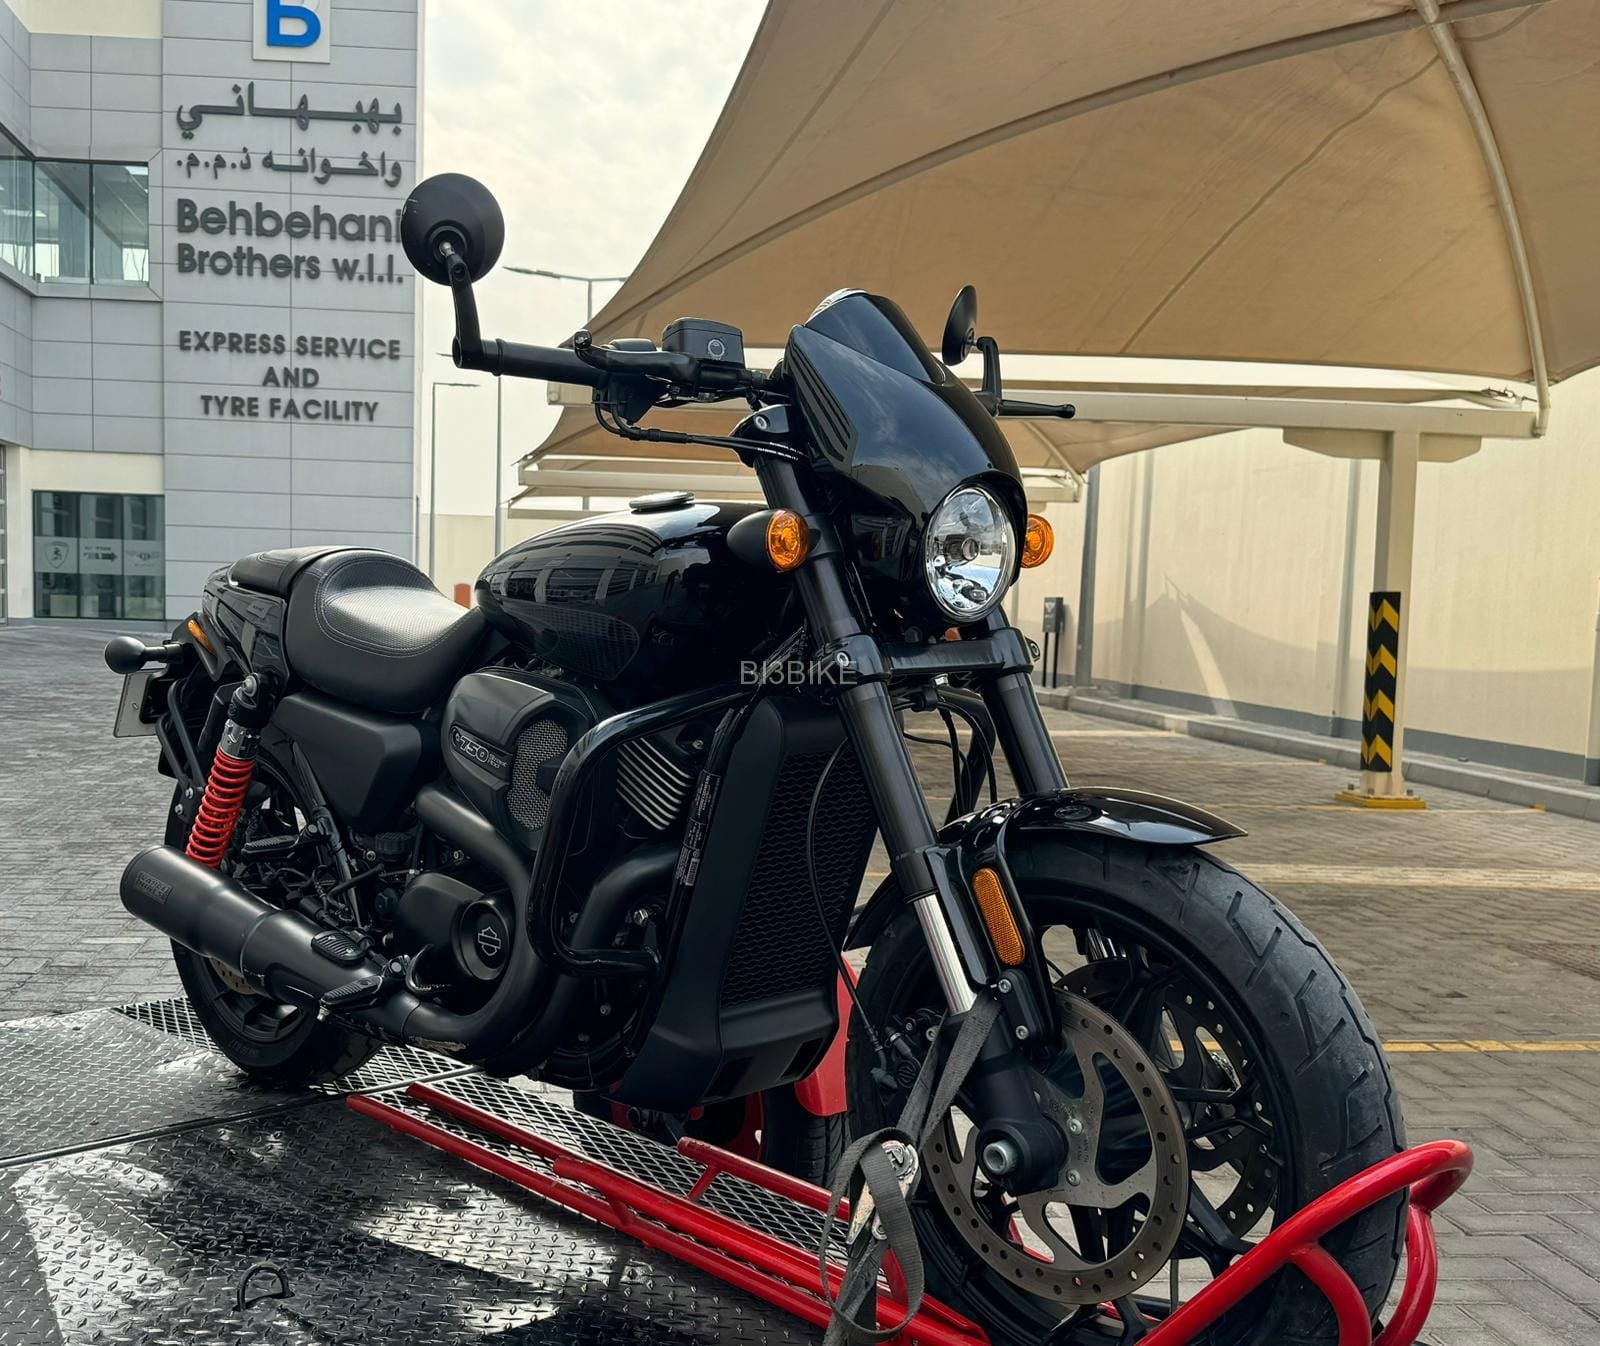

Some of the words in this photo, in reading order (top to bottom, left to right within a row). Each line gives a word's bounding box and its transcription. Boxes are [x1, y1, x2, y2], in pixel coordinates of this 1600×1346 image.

[177, 81, 402, 139] بهبهاني
[262, 147, 402, 187] واخوانه
[177, 198, 402, 243] Behbehani
[177, 243, 321, 280] Brothers
[332, 253, 404, 283] w.l.l.
[179, 330, 286, 355] EXPRESS
[296, 335, 401, 360] SERVICE
[262, 366, 320, 388] AND
[200, 394, 259, 417] TYRE
[269, 397, 379, 422] FACILITY
